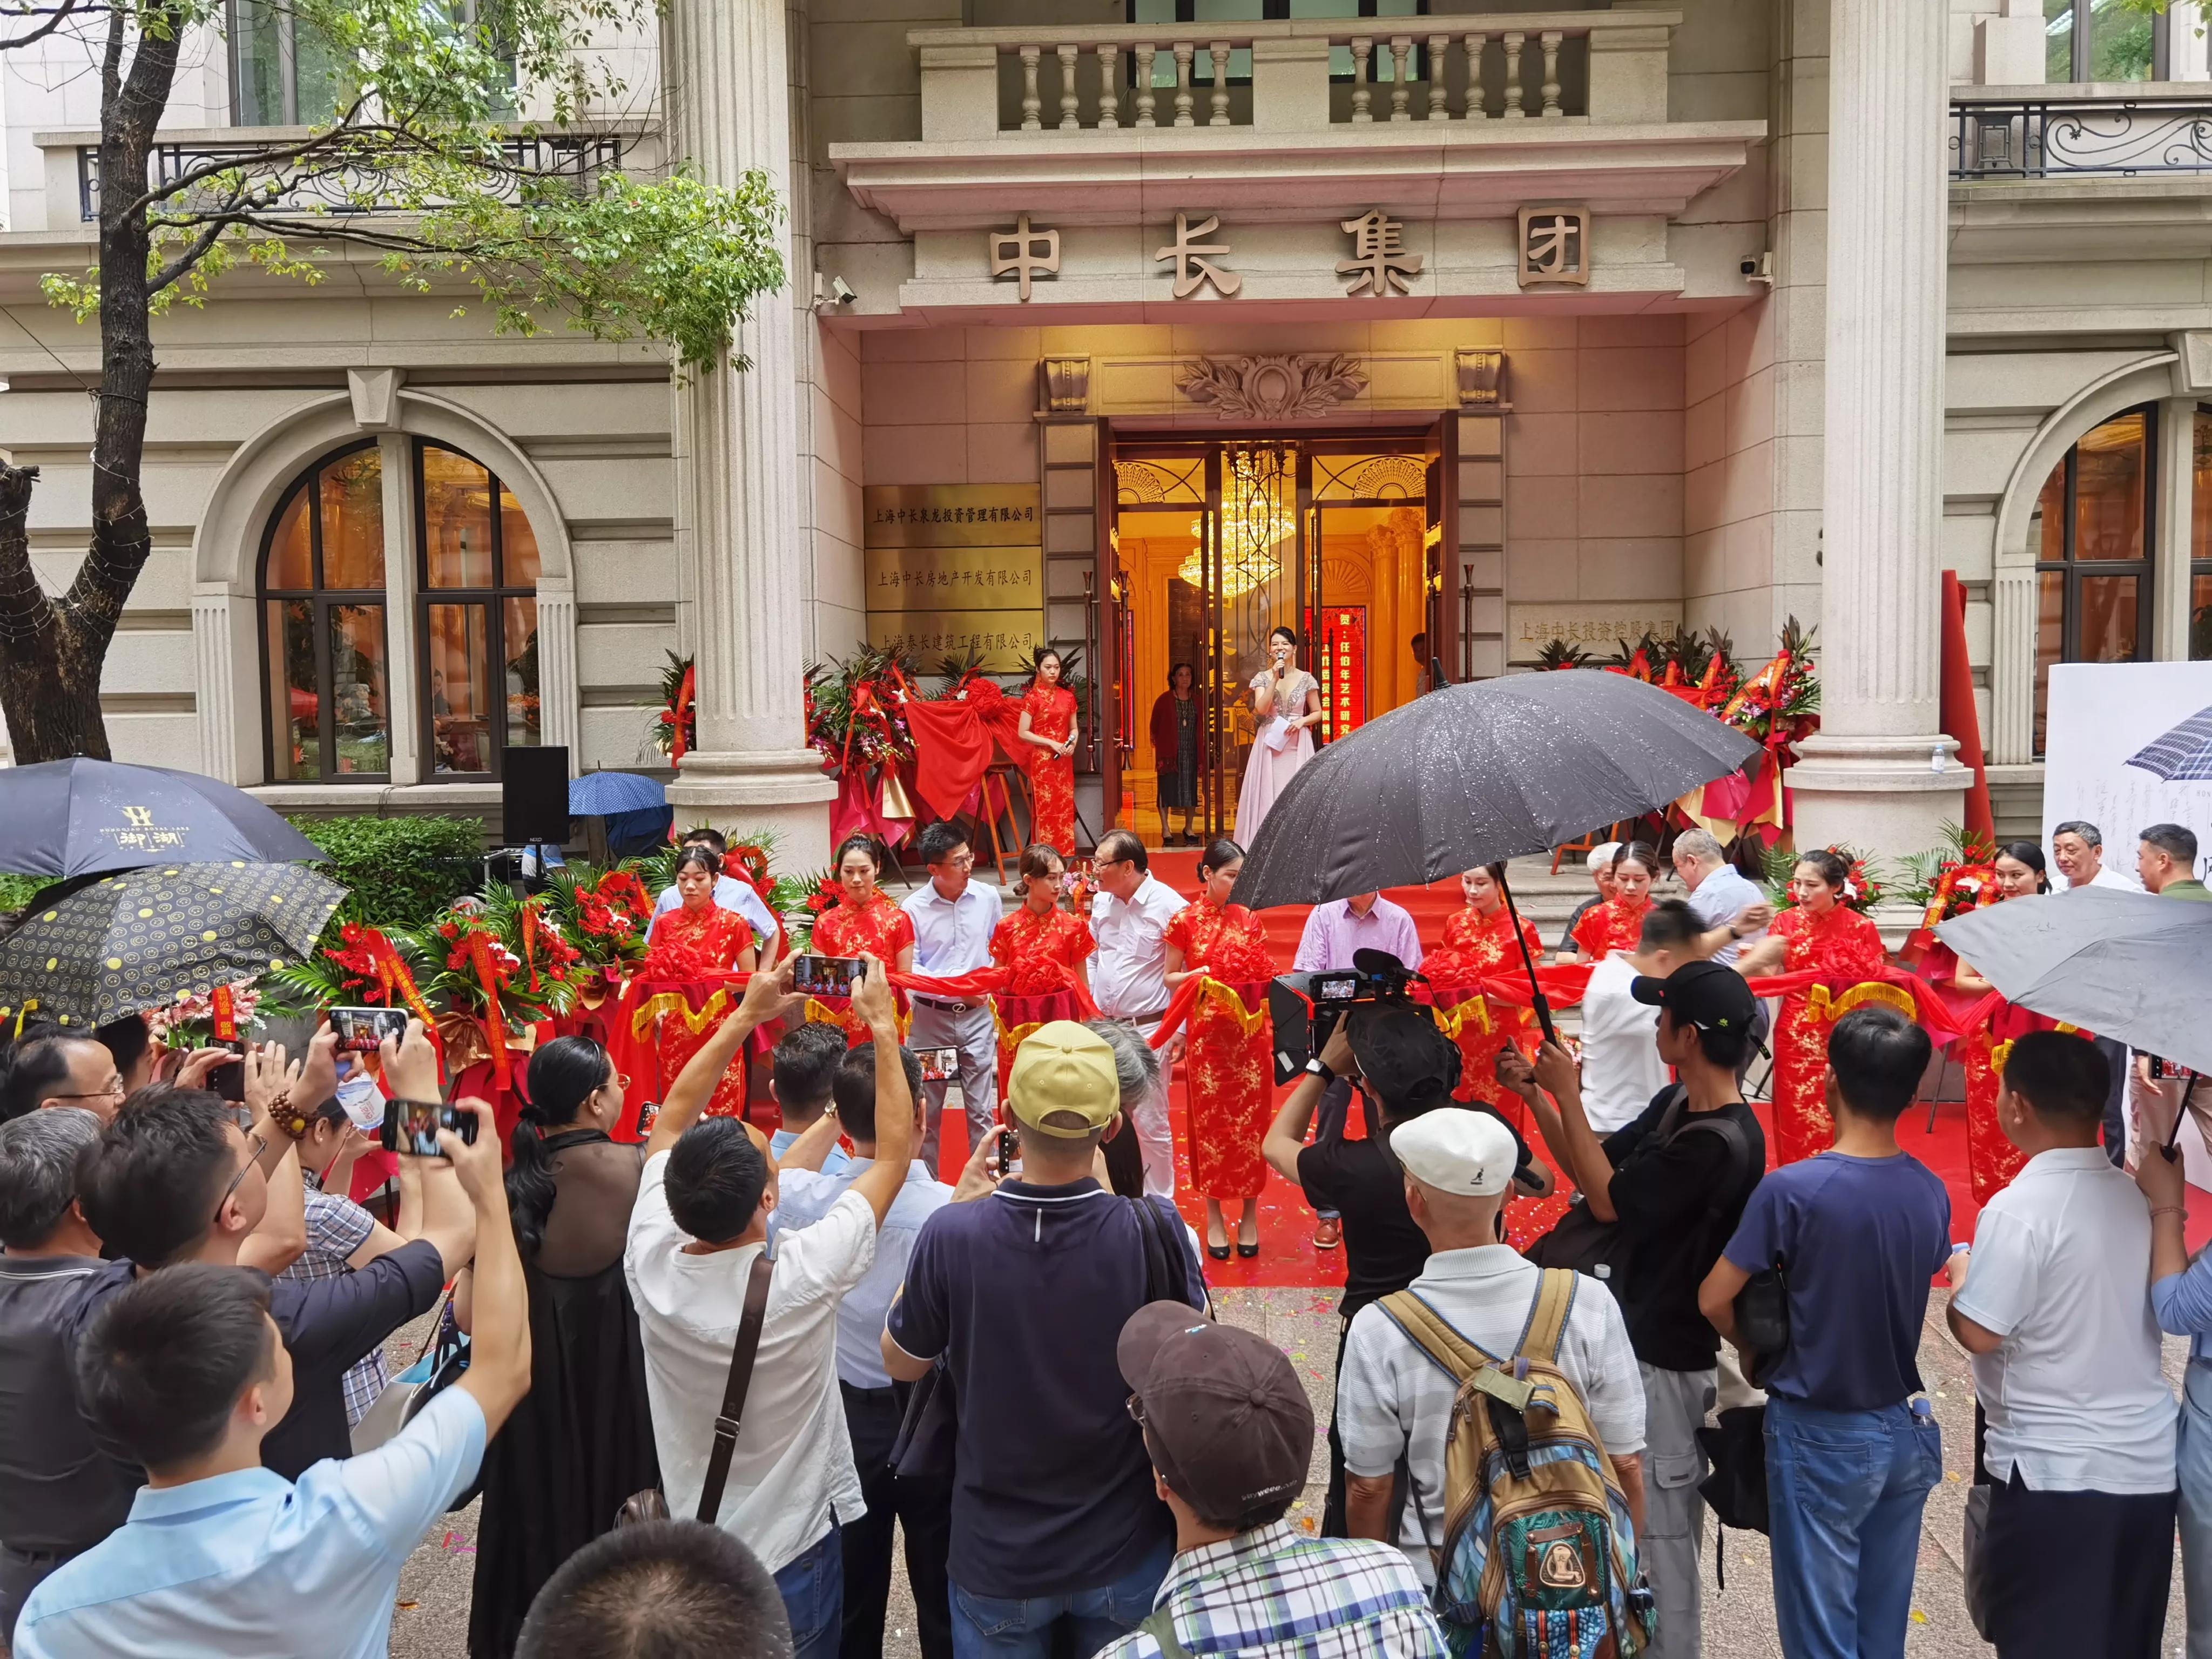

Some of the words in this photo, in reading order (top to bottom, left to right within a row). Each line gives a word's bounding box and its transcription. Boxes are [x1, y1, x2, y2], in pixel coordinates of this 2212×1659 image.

[990, 207, 1590, 301] 中长集团
[878, 569, 1031, 587] 上海中长房地产开发有限公司
[880, 632, 1032, 651] 上海泰长建筑工程有限公司
